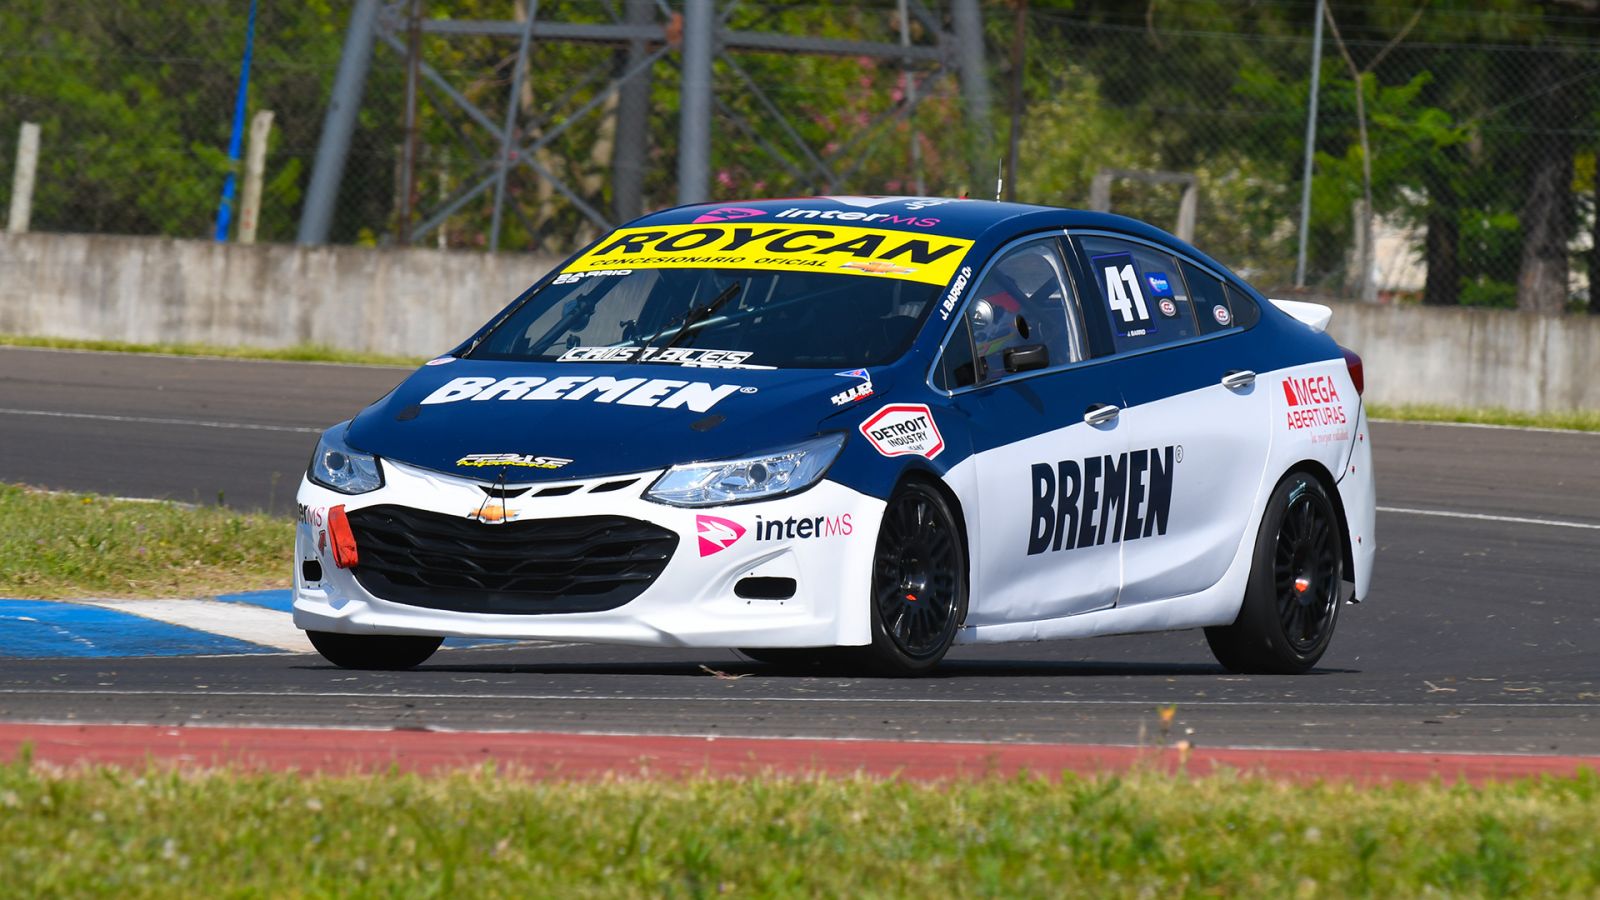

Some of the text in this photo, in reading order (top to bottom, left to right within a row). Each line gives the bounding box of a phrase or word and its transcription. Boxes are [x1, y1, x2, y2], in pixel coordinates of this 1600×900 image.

[774, 207, 941, 227] interMS
[591, 228, 964, 264] ROYCAN
[590, 256, 828, 267] CONCESIONARIO OFICIAL
[943, 274, 967, 312] BARRIO
[1104, 264, 1150, 322] 41
[420, 376, 741, 413] BREMEN
[1293, 376, 1340, 405] MEGA
[871, 416, 928, 441] DETROIT
[1287, 406, 1346, 430] ABERTURAS
[887, 431, 928, 448] INDUSTRY
[1027, 446, 1174, 556] BREMEN
[755, 513, 853, 541] interMS
